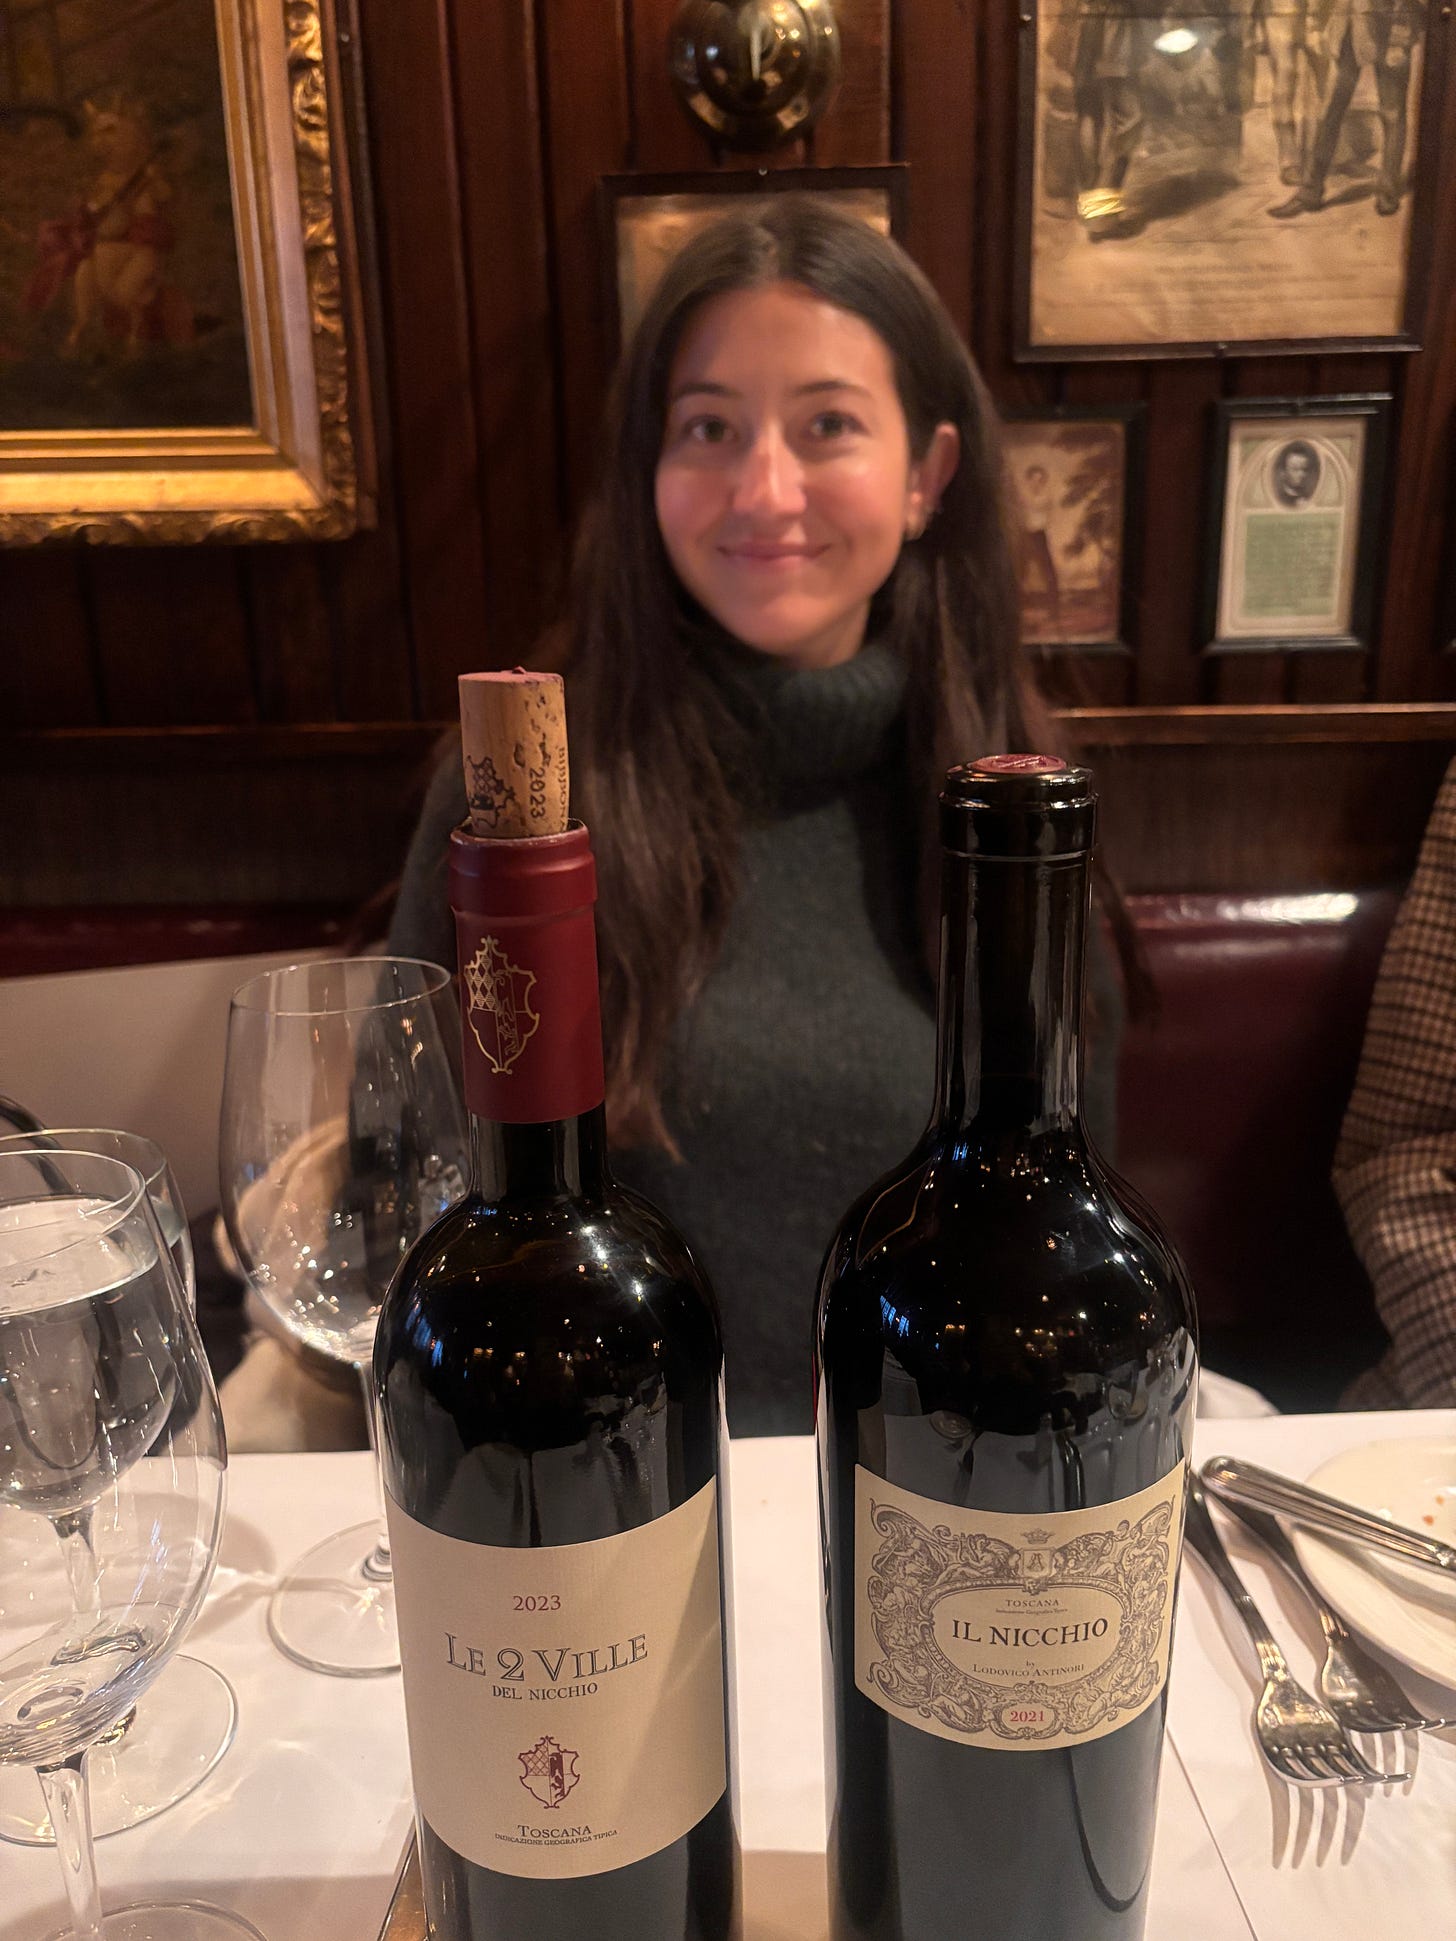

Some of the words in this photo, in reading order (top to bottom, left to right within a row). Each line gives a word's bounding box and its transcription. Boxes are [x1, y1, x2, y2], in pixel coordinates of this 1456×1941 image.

[529, 767, 546, 819] 2023
[512, 1594, 562, 1611] 2023
[1005, 1598, 1060, 1608] TOSCANA
[951, 1619, 983, 1643] IL
[988, 1617, 1109, 1649] NICCHIO
[497, 1647, 525, 1682] 2
[531, 1633, 649, 1682] VILLE
[1025, 1659, 1036, 1668] by
[972, 1663, 1031, 1677] LODOVICO
[1032, 1663, 1085, 1677] ANTINORI
[492, 1684, 523, 1700] DEL
[529, 1682, 599, 1701] NICCHIO
[1009, 1710, 1045, 1723] 2021
[517, 1824, 592, 1839] TOSCANA
[593, 1829, 618, 1841] TIPICA
